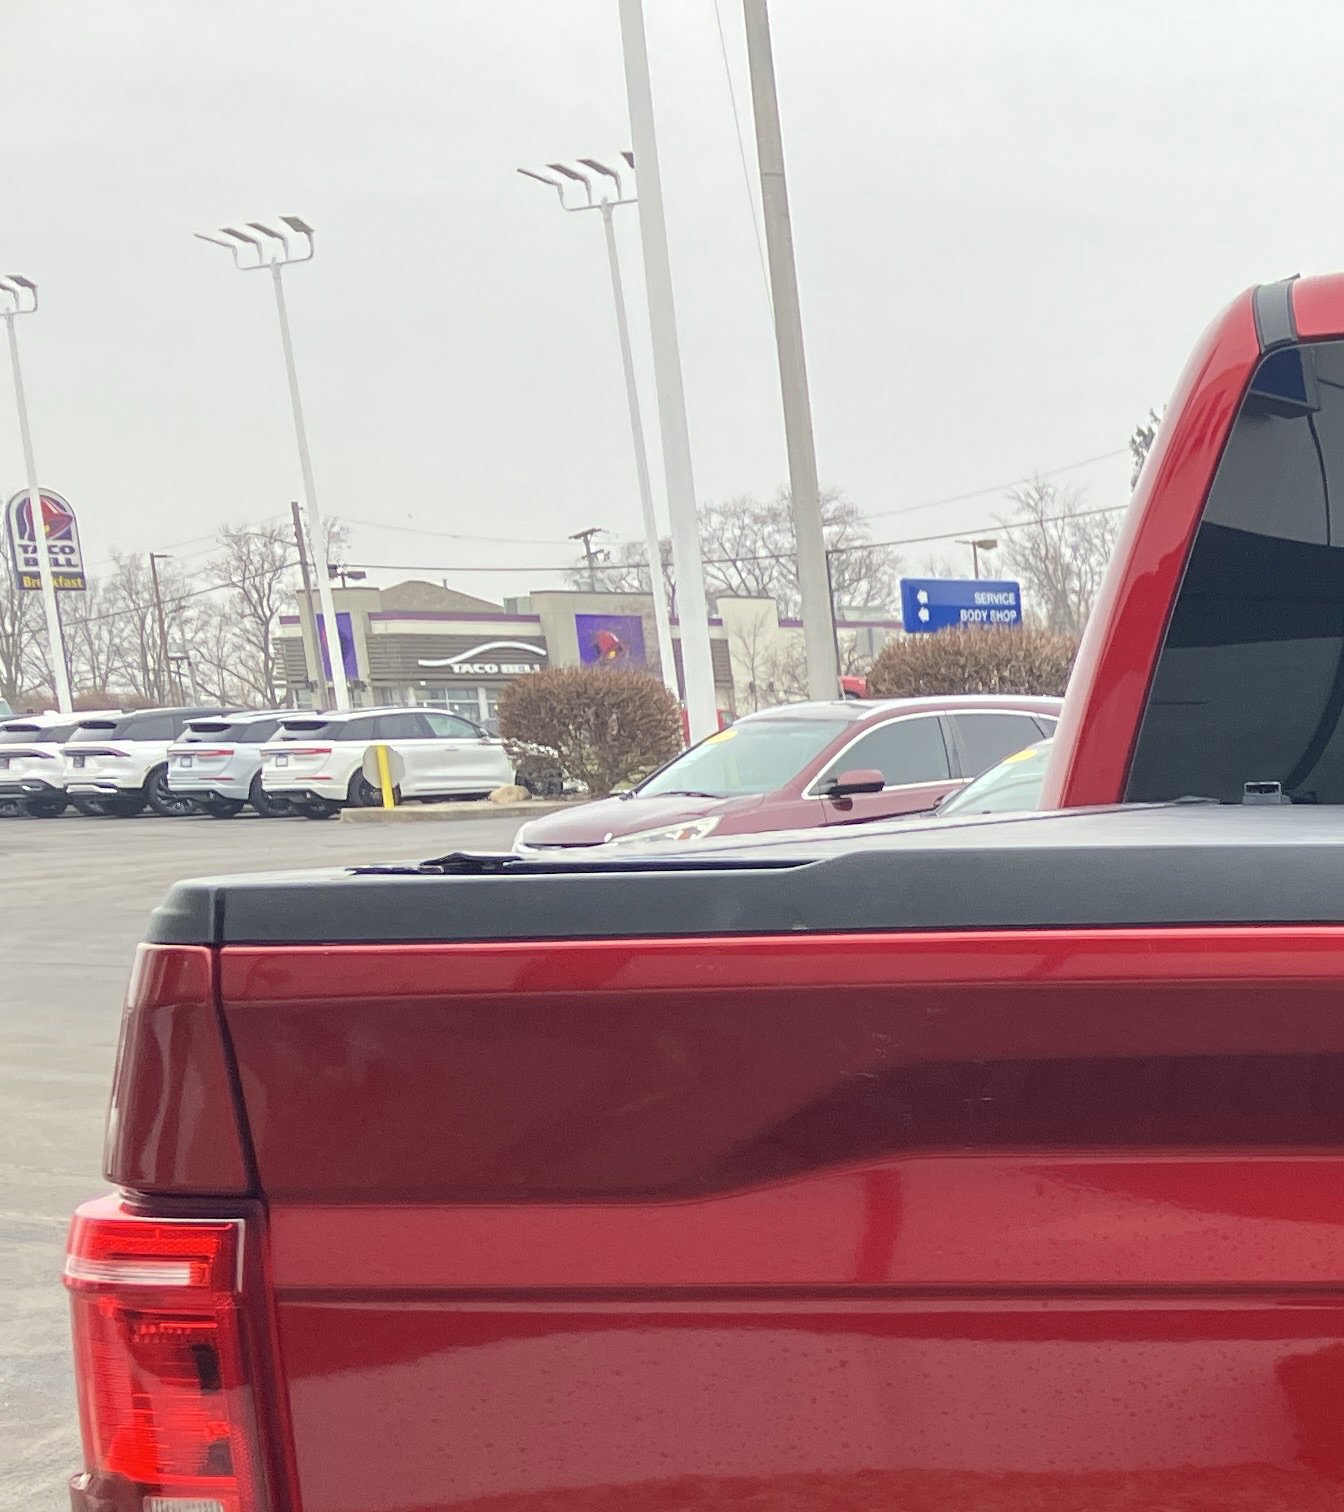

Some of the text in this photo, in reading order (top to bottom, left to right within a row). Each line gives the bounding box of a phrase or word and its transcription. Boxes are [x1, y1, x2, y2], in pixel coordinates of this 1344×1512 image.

[23, 557, 79, 568] BLL
[22, 575, 84, 588] Brkfast
[974, 591, 1016, 605] SERVICE
[960, 609, 1017, 622] BODY SHOP
[452, 663, 499, 674] TACO
